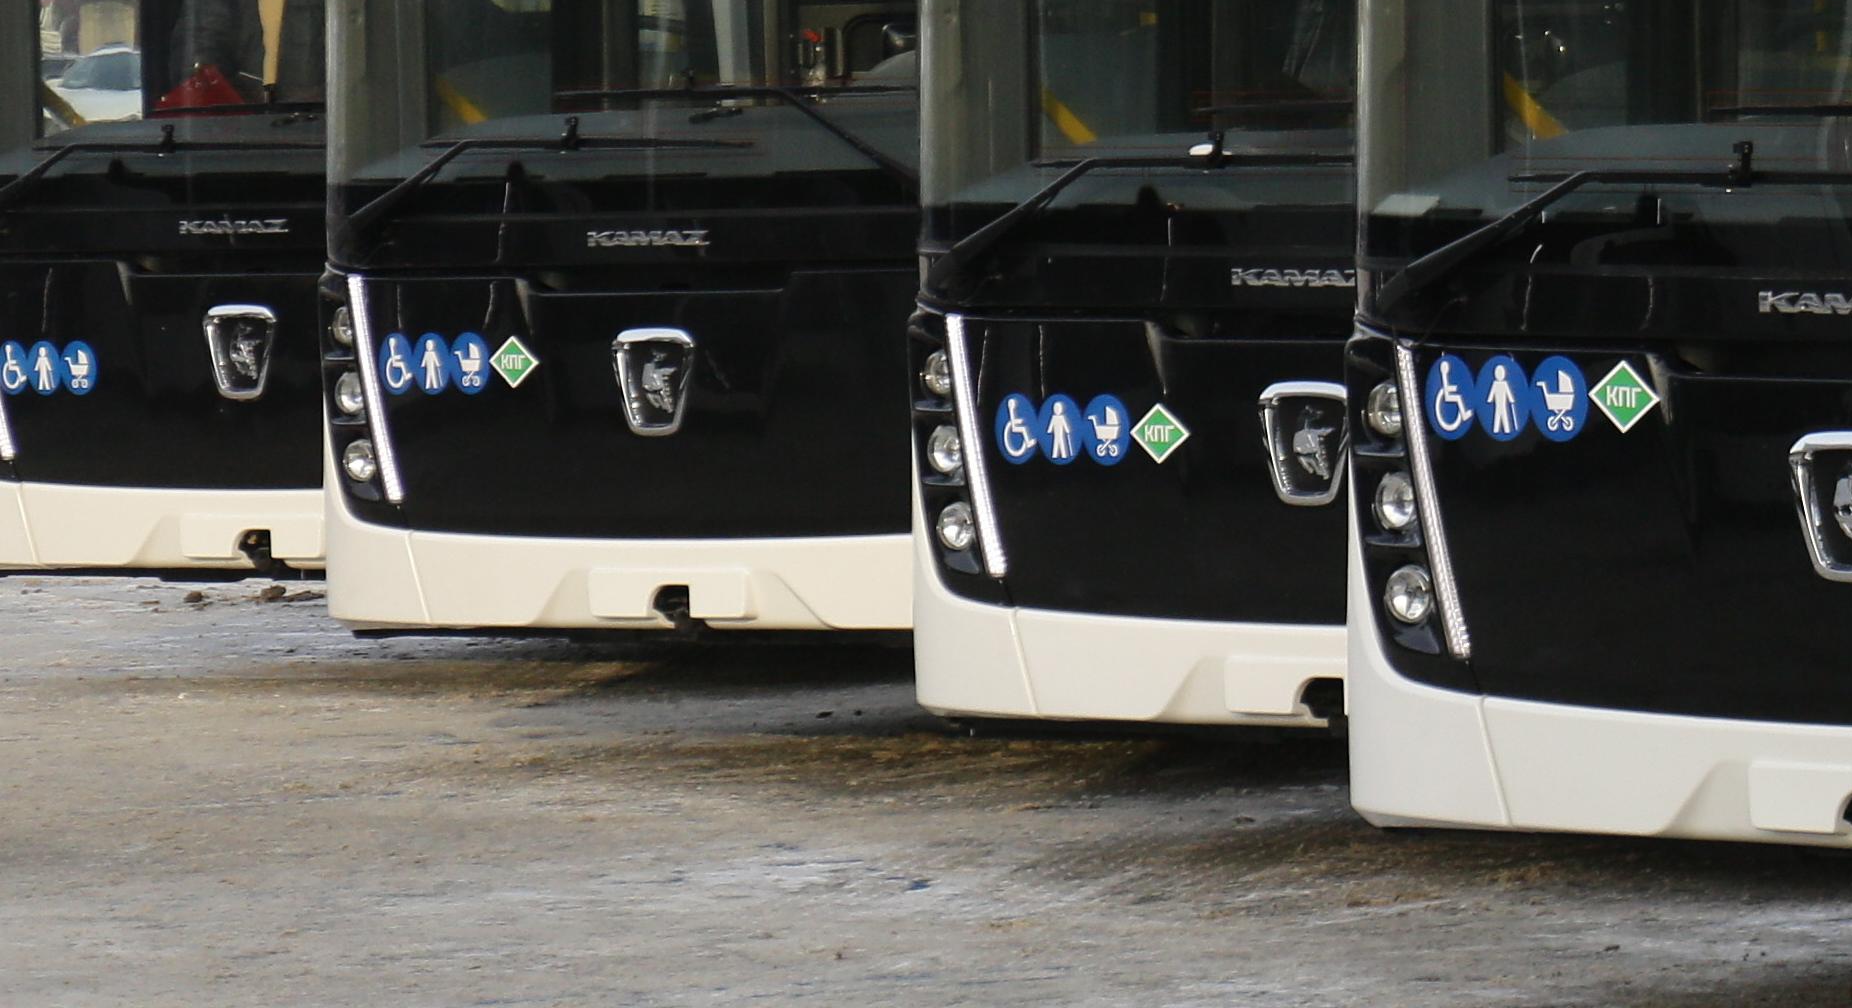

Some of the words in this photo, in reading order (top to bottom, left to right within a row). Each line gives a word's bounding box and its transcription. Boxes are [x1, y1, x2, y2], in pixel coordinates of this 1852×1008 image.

[179, 219, 289, 234] KAMAZ
[585, 229, 710, 247] KAMAZ
[500, 353, 527, 371] КПГ
[1606, 385, 1643, 408] КПГ
[1144, 424, 1175, 442] КПГ
